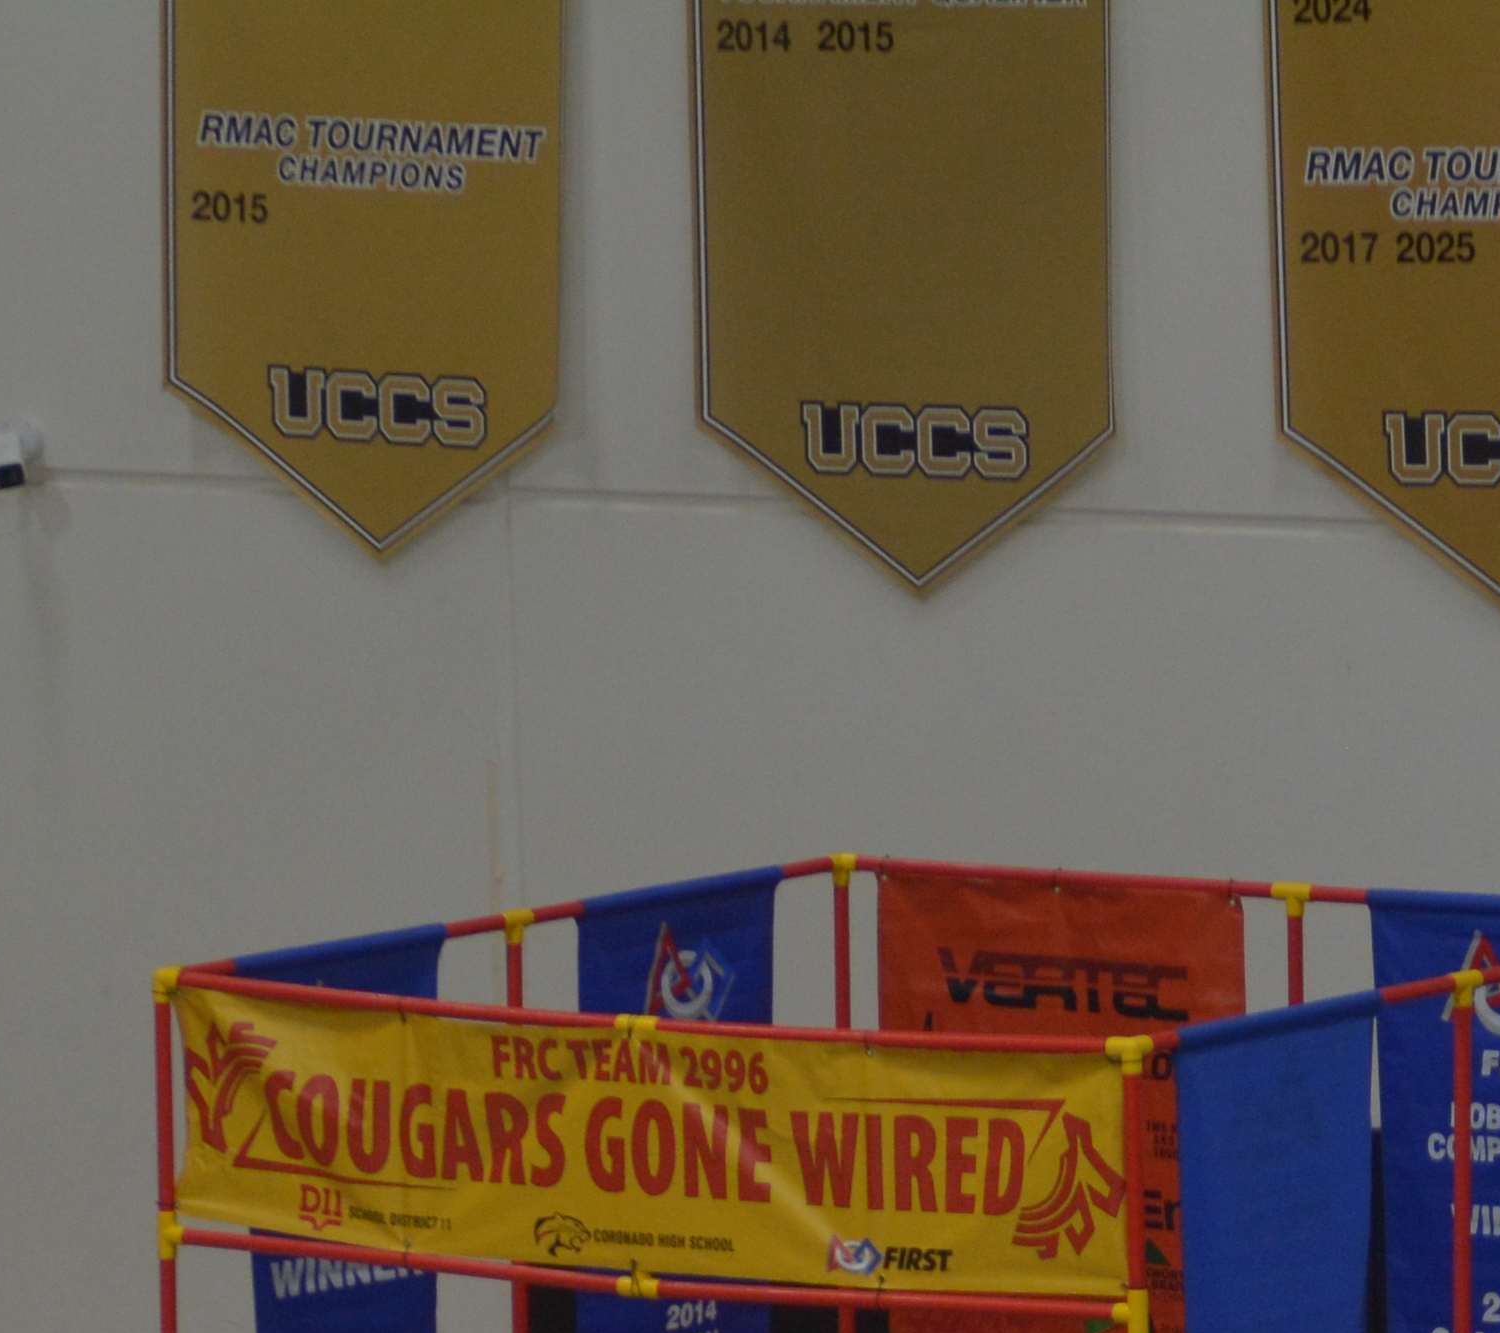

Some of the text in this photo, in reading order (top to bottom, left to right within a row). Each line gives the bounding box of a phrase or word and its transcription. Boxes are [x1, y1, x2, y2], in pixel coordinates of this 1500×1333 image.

[1294, 0, 1372, 23] 2024
[716, 20, 895, 53] 2014 2015
[199, 113, 544, 158] RMAC TOURNAMENT
[278, 156, 466, 190] CHAMPIONS
[1306, 149, 1413, 182] RMAC
[191, 191, 269, 224] 2015
[1301, 230, 1477, 264] 2017 2025
[268, 364, 488, 449] UCCS
[800, 401, 1030, 481] UCCS
[491, 1034, 769, 1095] FRC TEAM 2996
[264, 1071, 1026, 1217] COUGARS GONE WIRED
[348, 1204, 387, 1226] SCHOOL
[593, 1228, 735, 1253] CORONADO HIGH SCHOOL
[882, 1246, 952, 1273] FIRST
[665, 1299, 717, 1331] 2014
